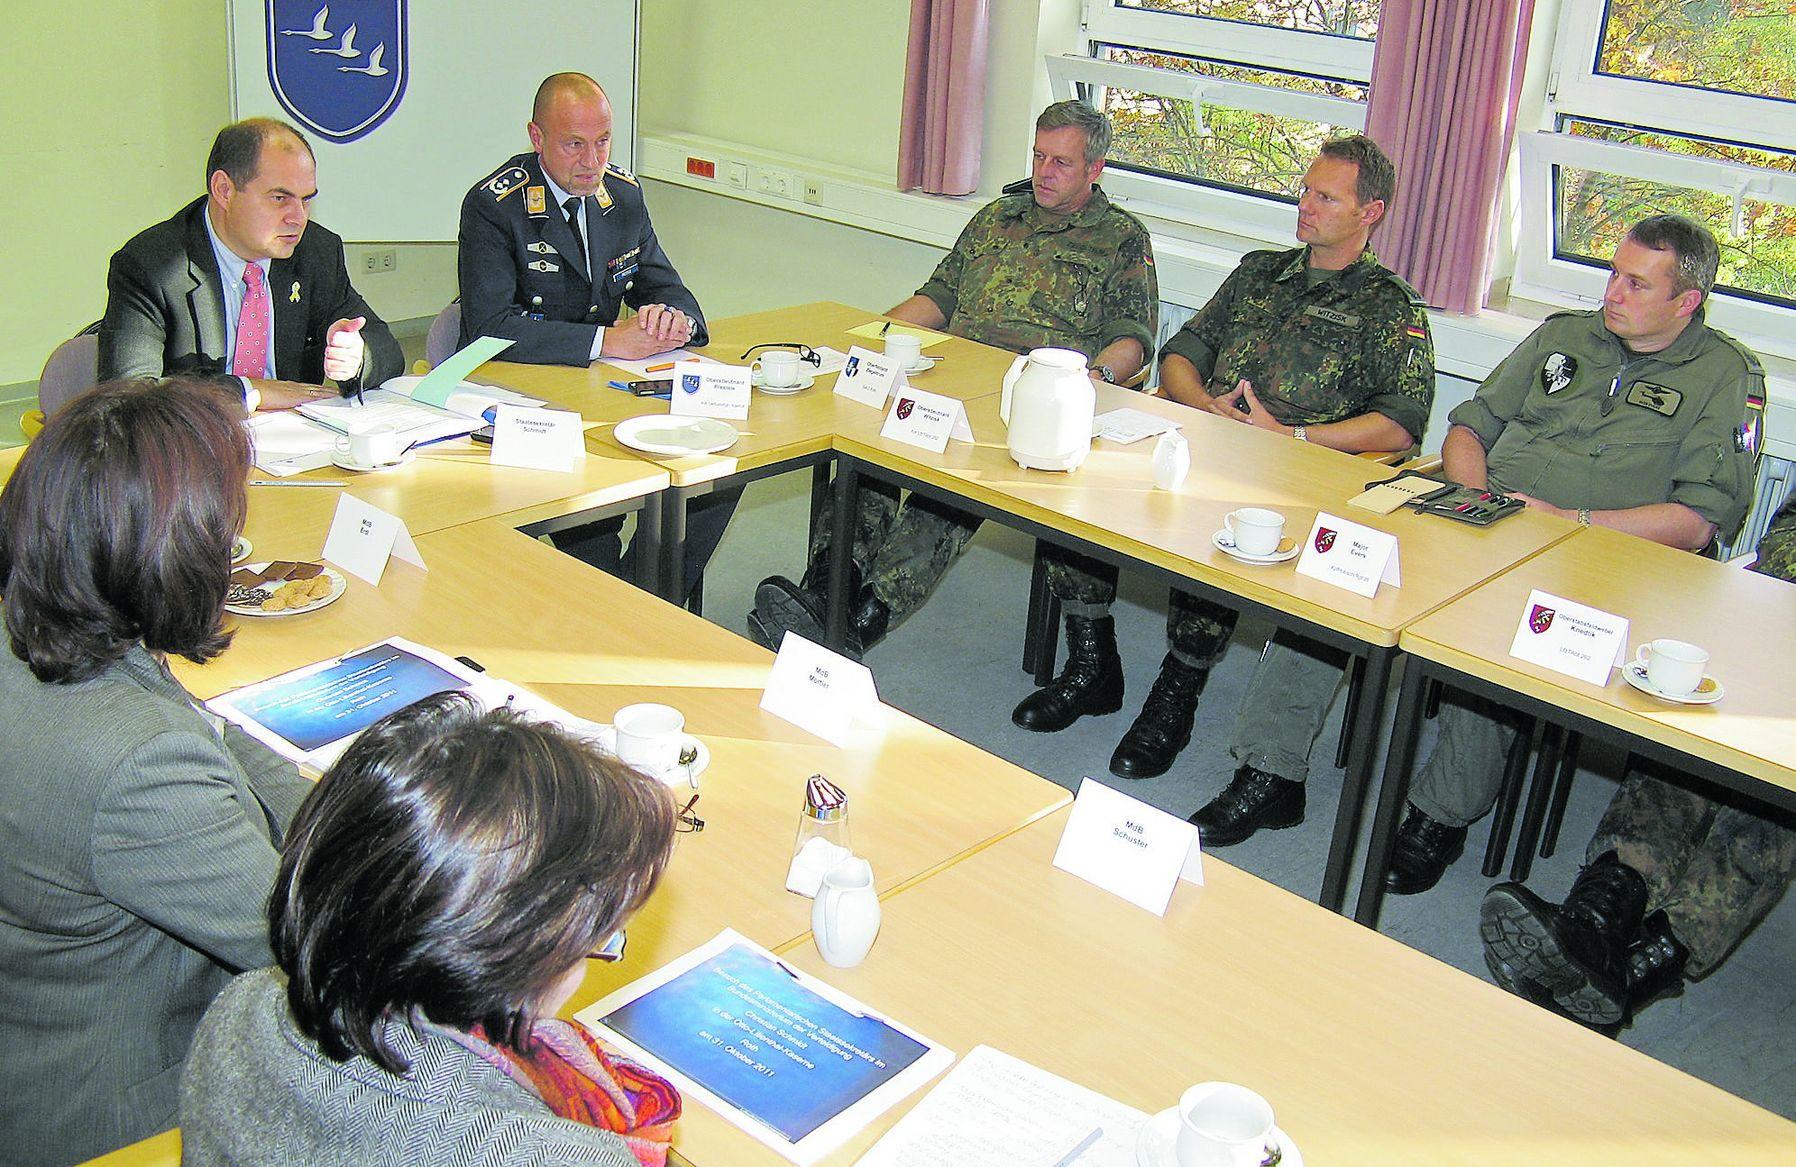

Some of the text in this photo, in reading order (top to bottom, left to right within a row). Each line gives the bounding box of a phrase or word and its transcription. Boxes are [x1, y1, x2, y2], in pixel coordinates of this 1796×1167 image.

[1352, 541, 1369, 551] Major
[1126, 821, 1144, 834] MdB
[1113, 828, 1148, 848] Schuster
[745, 1010, 808, 1049] Christian Schmidt
[740, 1039, 759, 1052] Roth
[792, 1024, 806, 1034] der
[807, 1030, 853, 1061] Verteidigung
[699, 1031, 713, 1041] am
[724, 1045, 755, 1066] Oktober
[753, 1063, 776, 1077] 2011
